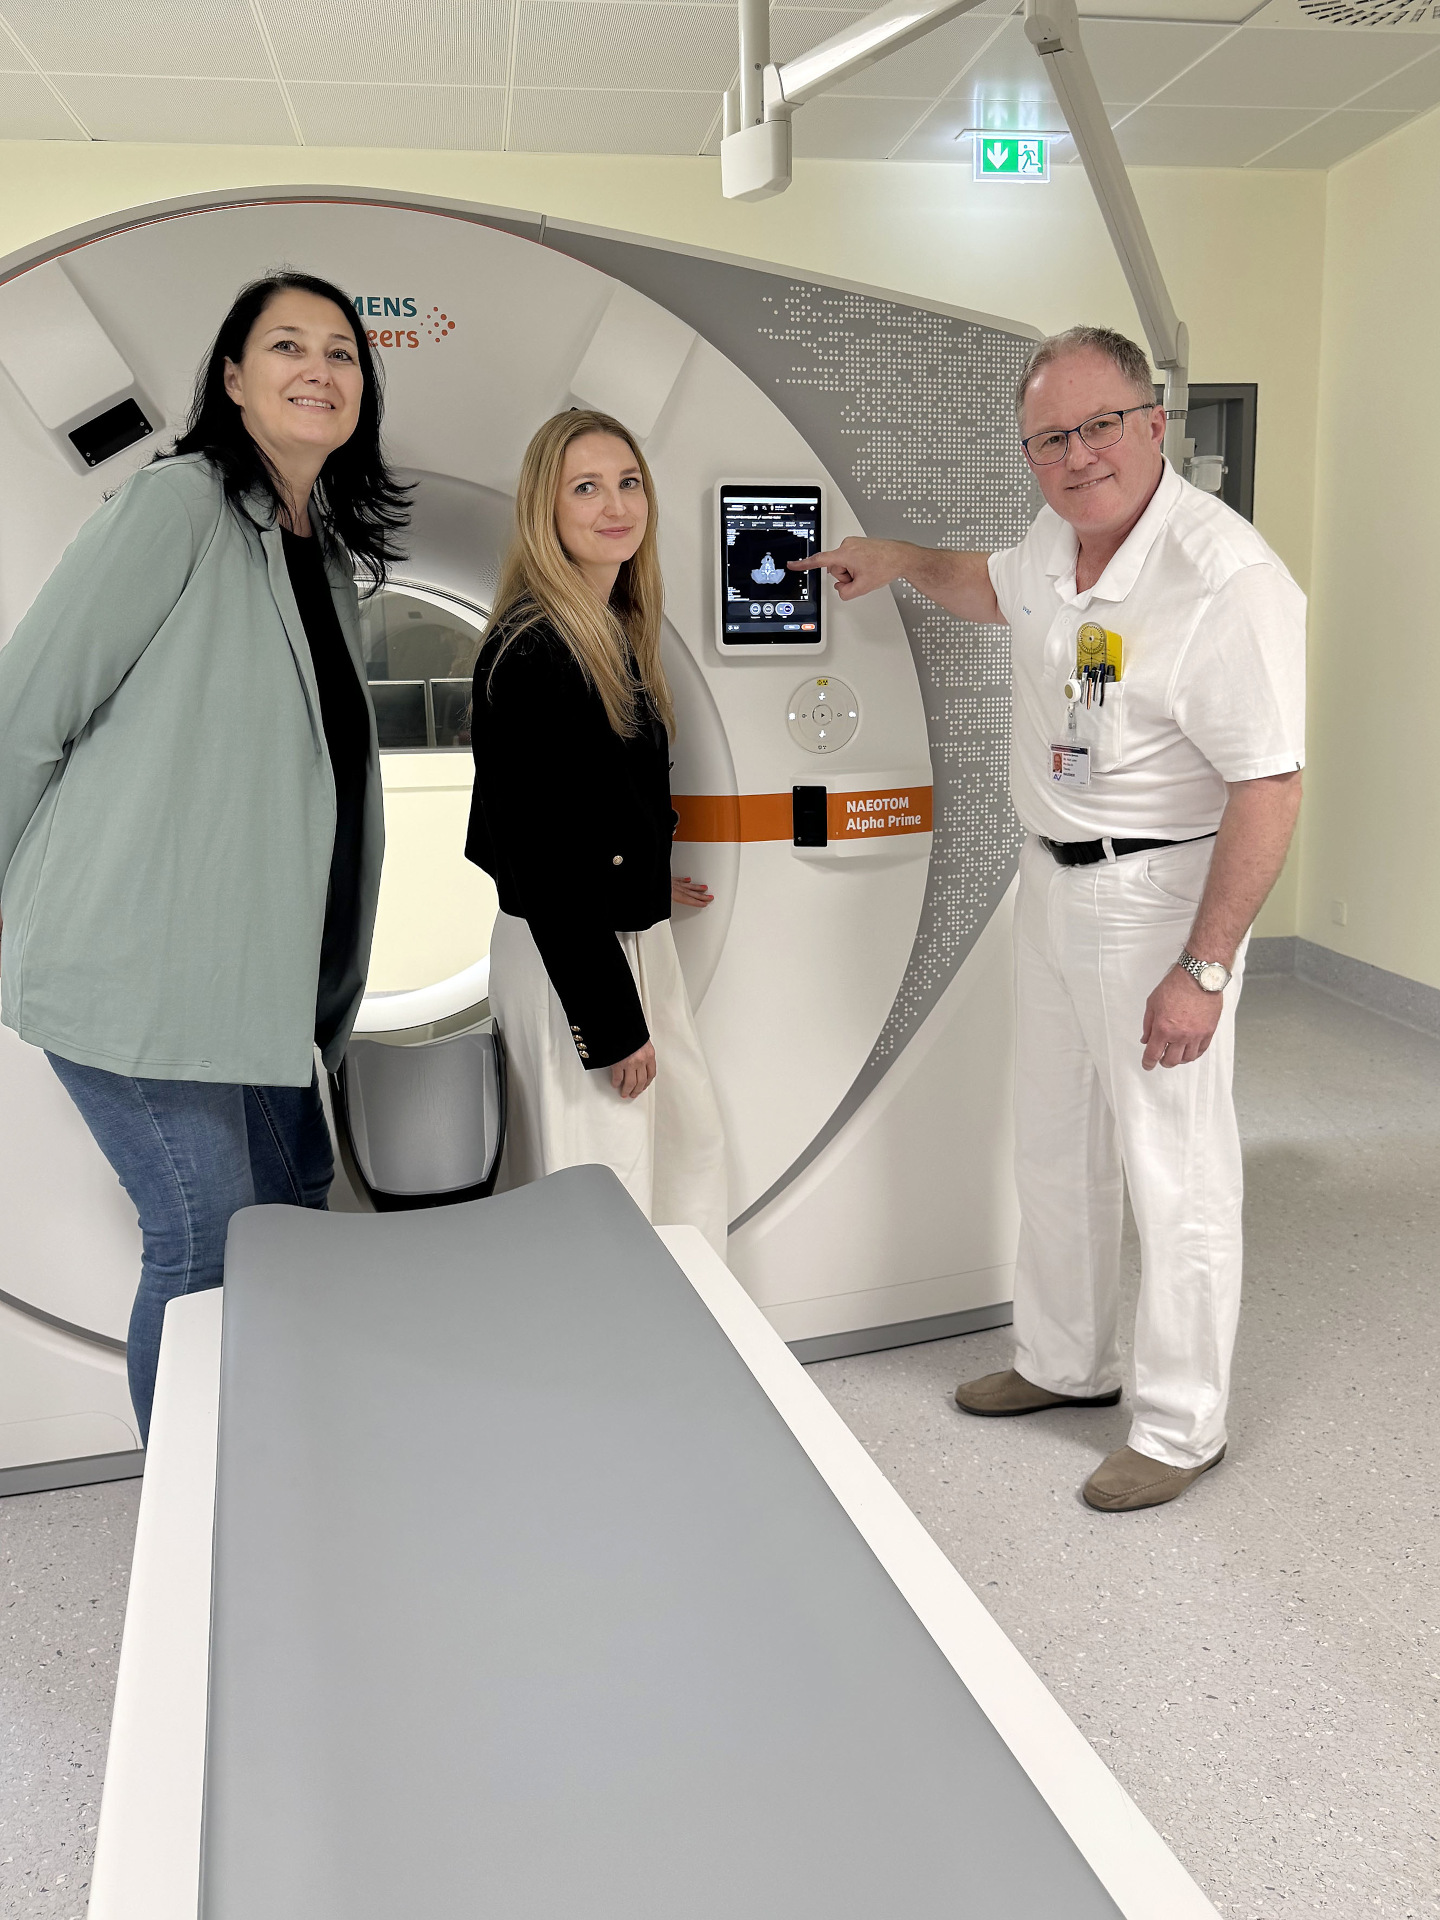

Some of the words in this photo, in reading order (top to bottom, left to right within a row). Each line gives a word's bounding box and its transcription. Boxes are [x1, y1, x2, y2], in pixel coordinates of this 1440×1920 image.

[846, 797, 909, 813] NAEOTOM
[846, 817, 885, 833] Alpha
[888, 813, 921, 828] Prime
